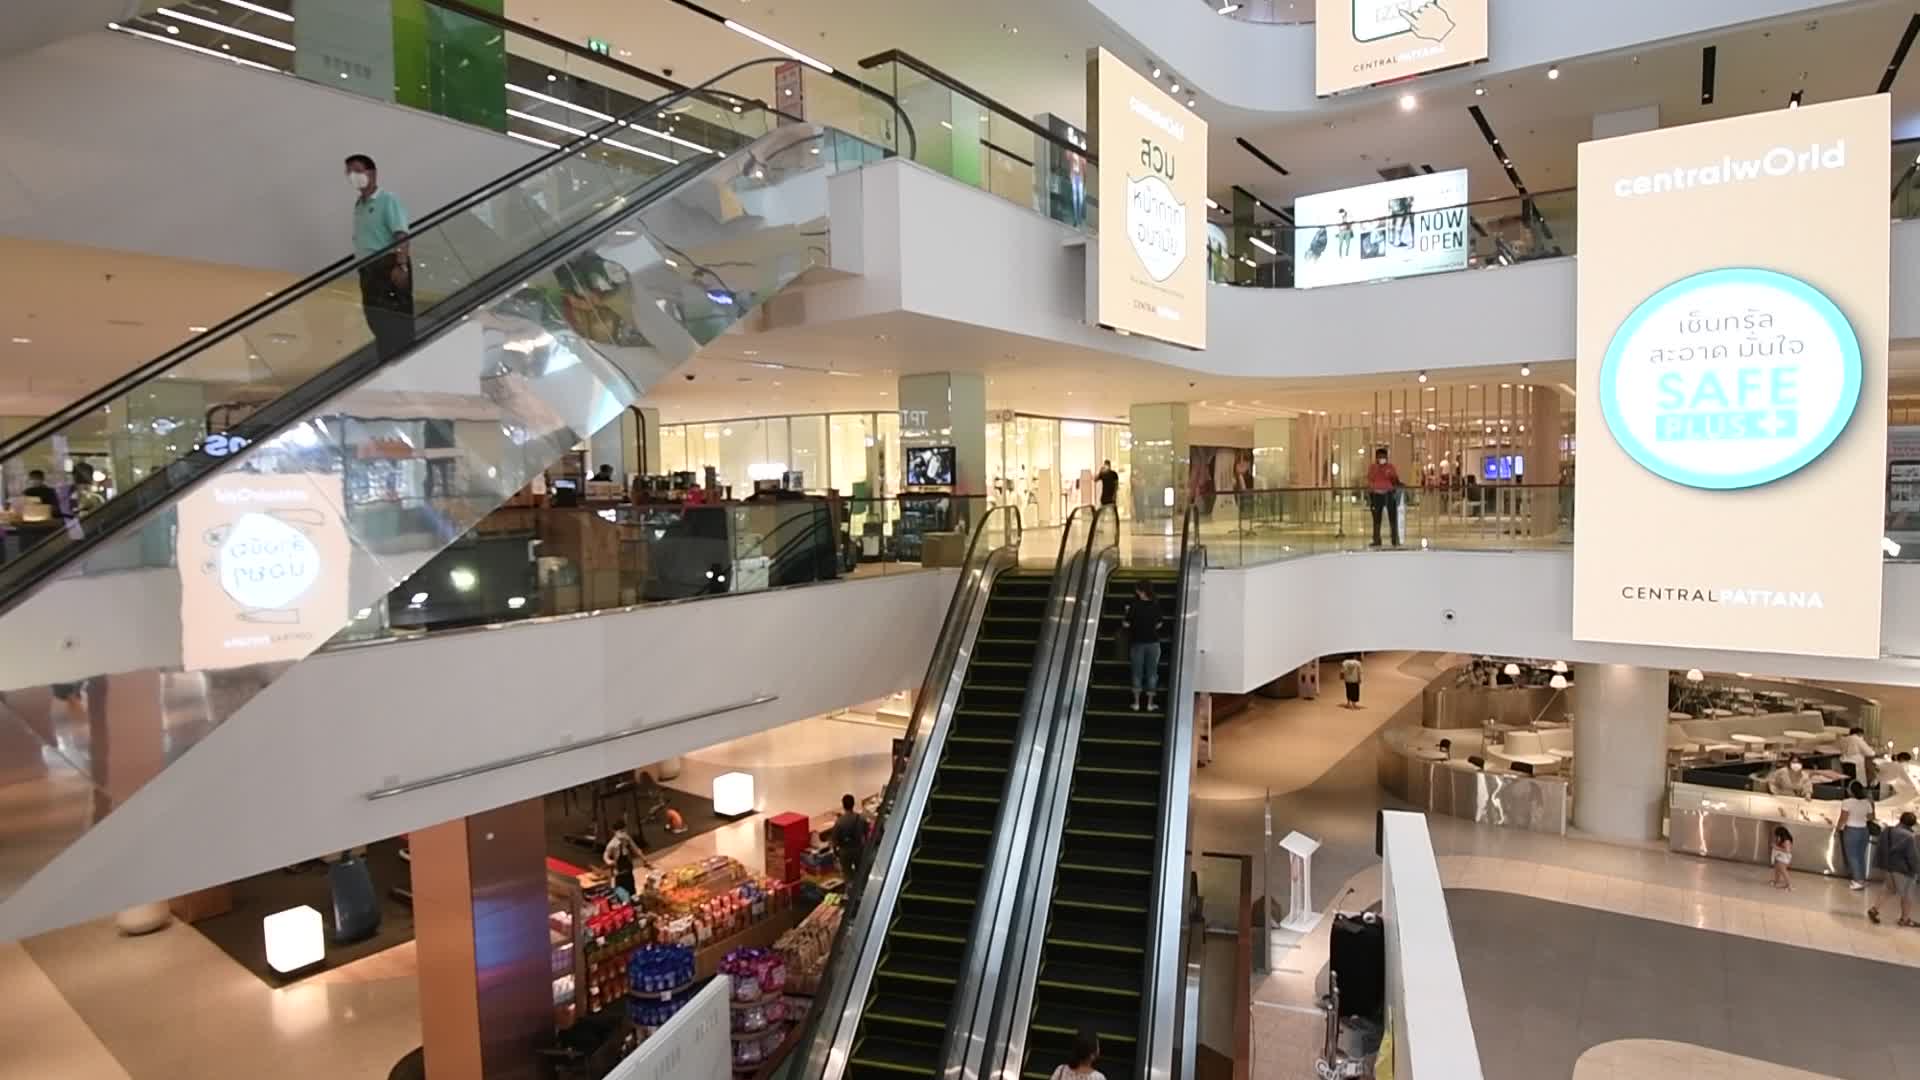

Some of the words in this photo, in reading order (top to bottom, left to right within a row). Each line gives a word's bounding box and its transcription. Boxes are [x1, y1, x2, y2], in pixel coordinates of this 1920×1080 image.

[1420, 208, 1463, 232] NOW
[1420, 231, 1463, 252] OPEN
[1657, 366, 1798, 410] SAFE
